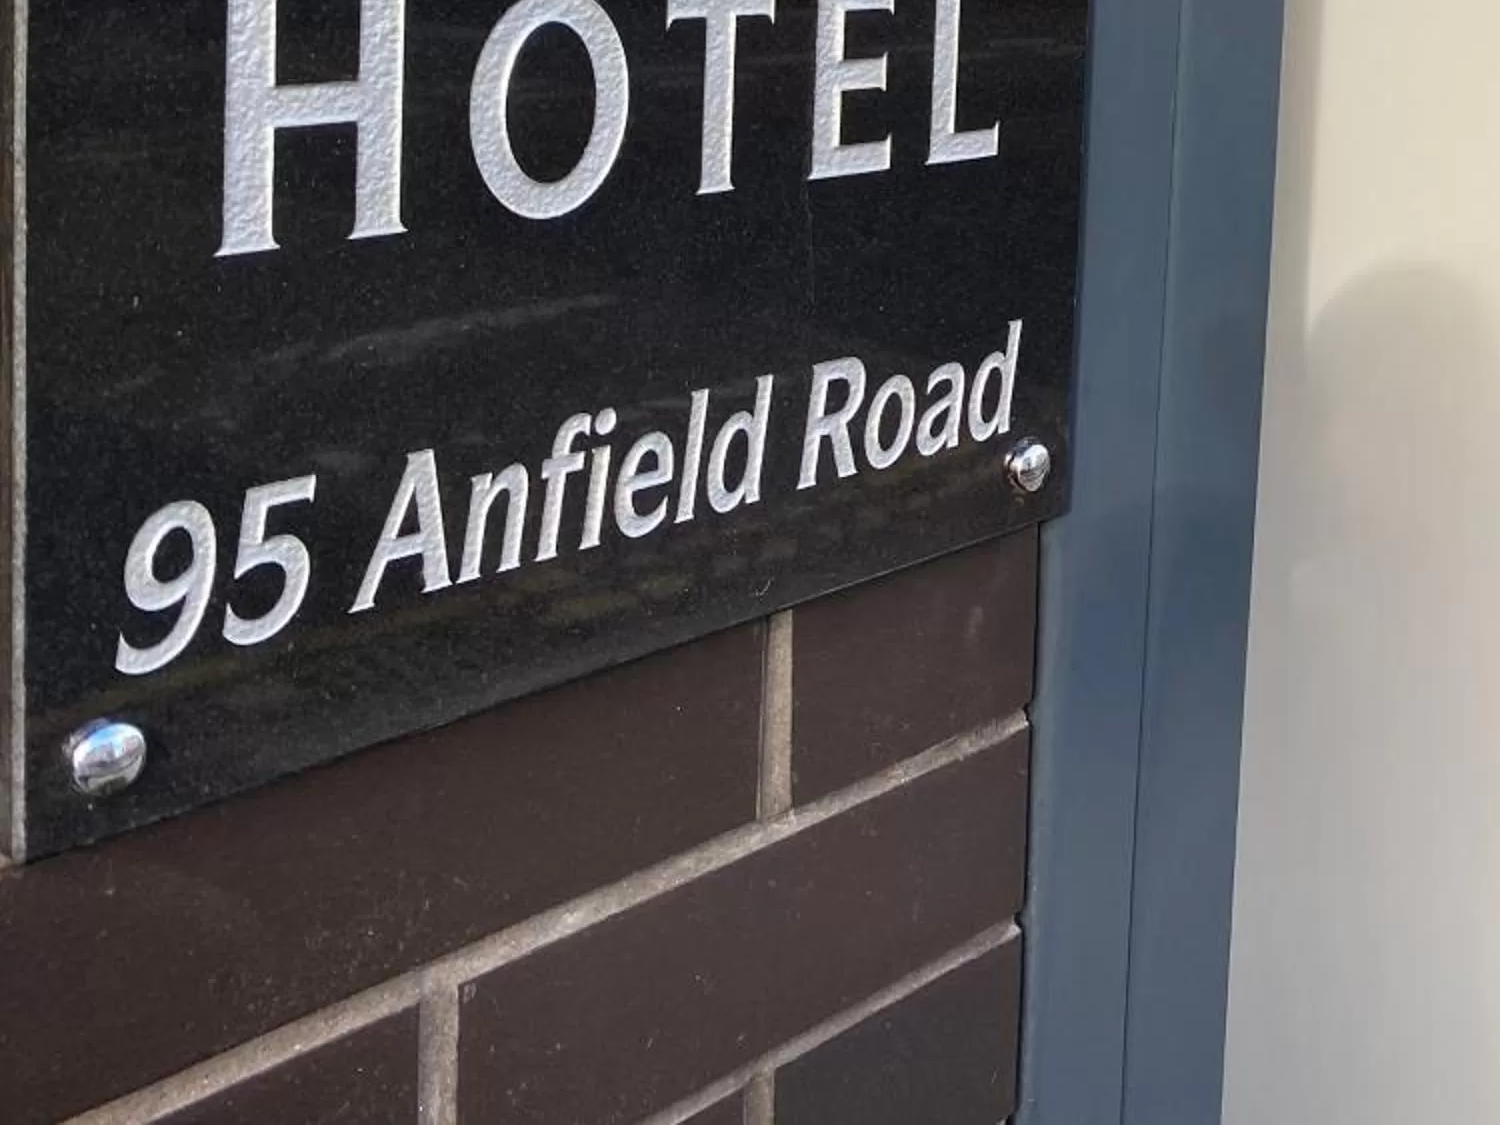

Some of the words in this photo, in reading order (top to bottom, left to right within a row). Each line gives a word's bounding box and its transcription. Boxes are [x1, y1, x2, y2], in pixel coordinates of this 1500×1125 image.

[114, 475, 317, 675] 95
[348, 374, 774, 613] Anfield
[797, 319, 1023, 490] Road
